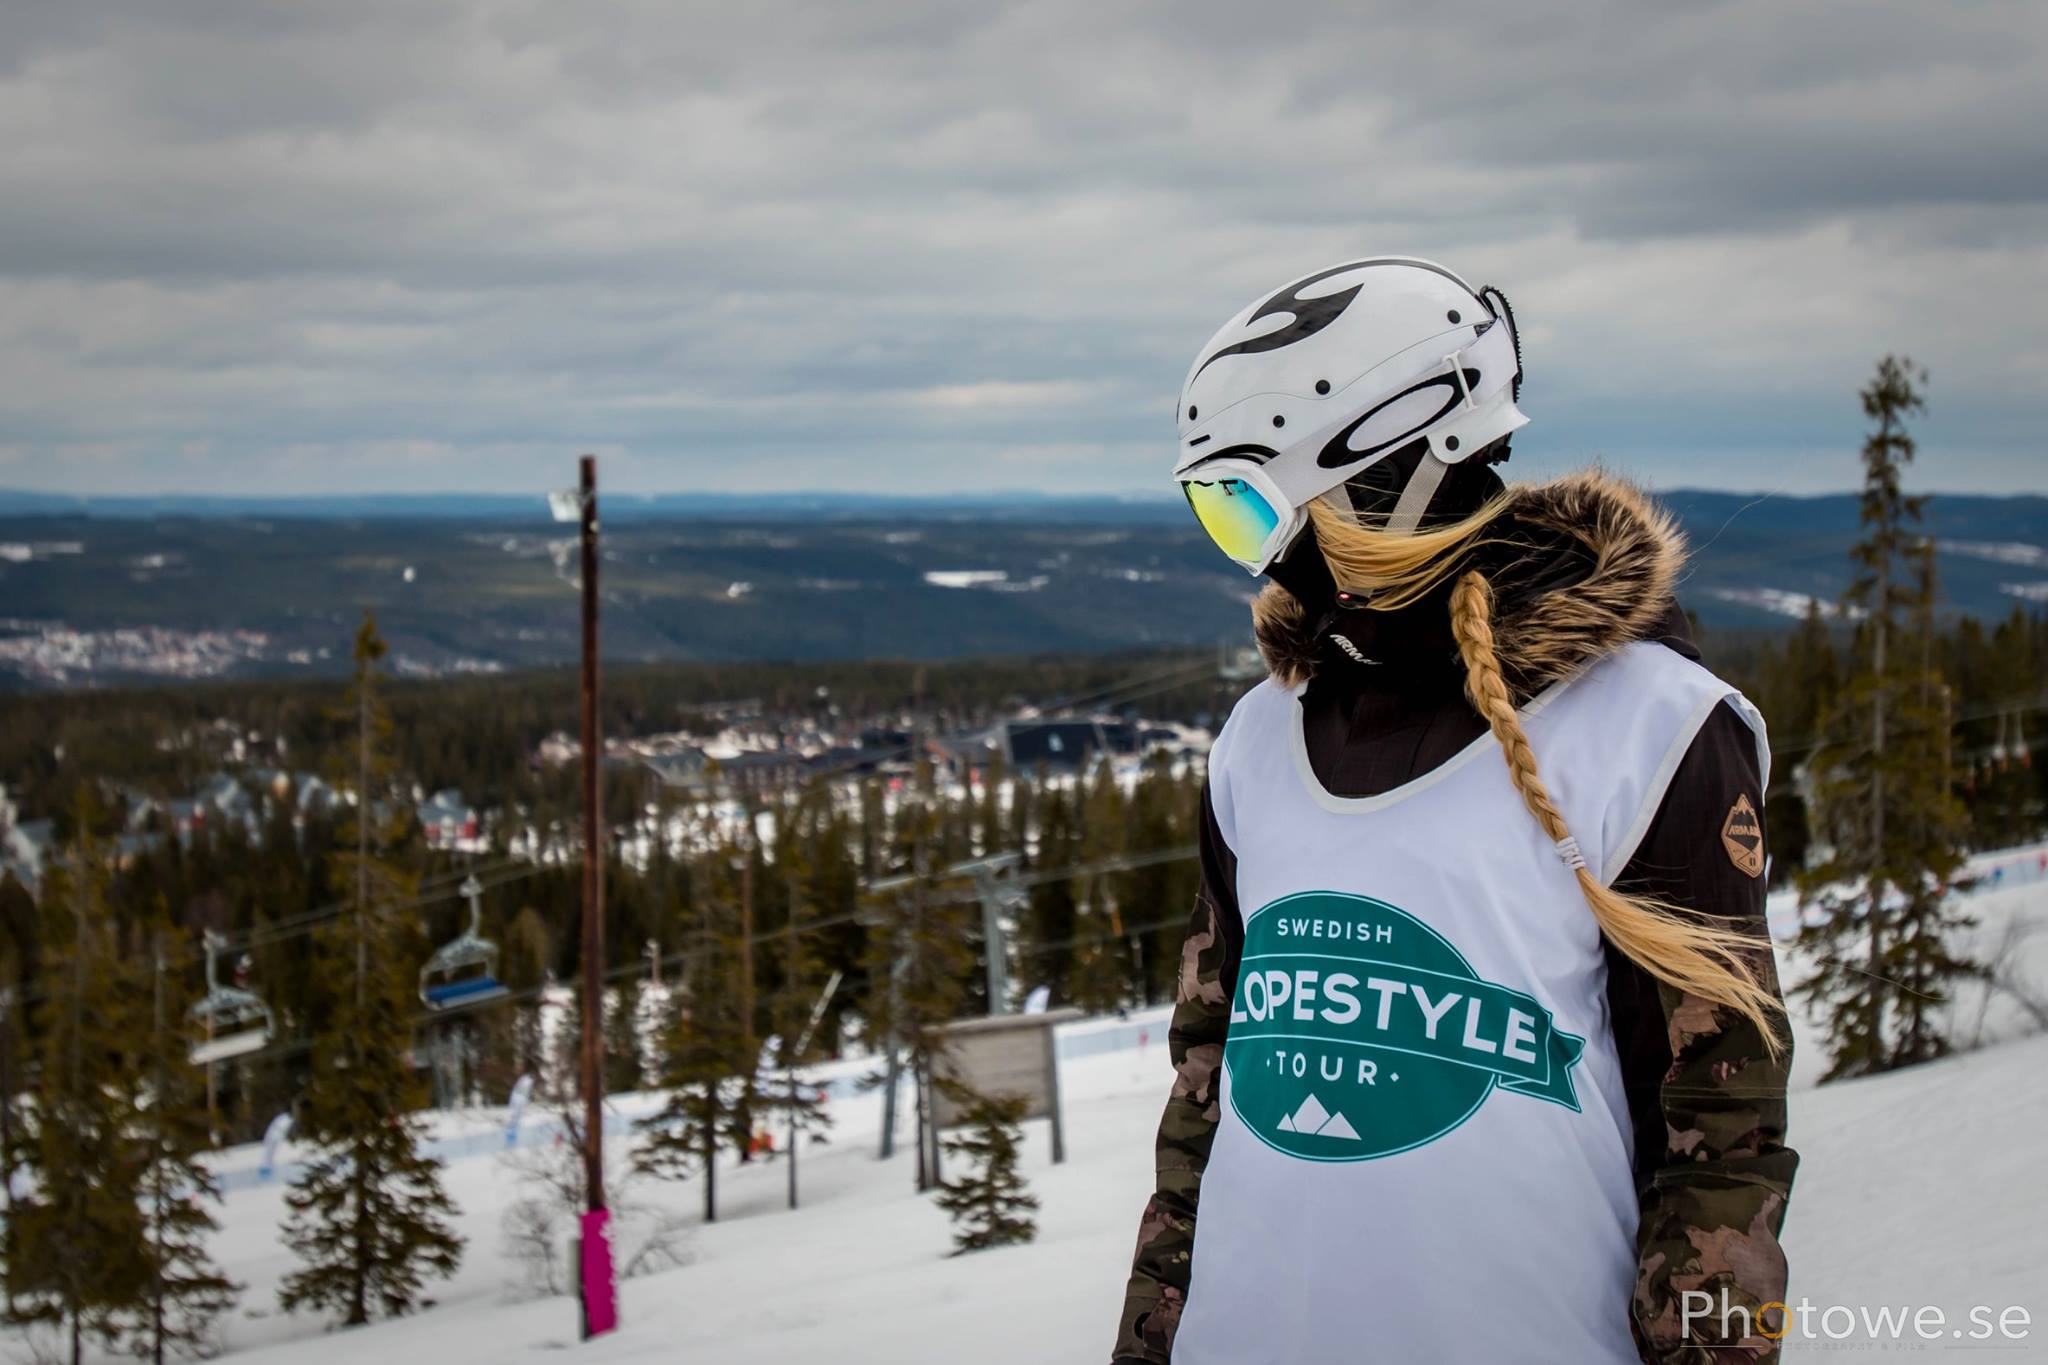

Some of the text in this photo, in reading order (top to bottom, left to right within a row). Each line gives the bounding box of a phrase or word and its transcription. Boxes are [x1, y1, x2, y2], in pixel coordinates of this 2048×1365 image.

[1276, 918, 1393, 944] SWEDISH
[1230, 970, 1537, 1065] LOPESTYLE
[1275, 1050, 1377, 1086] TOUR
